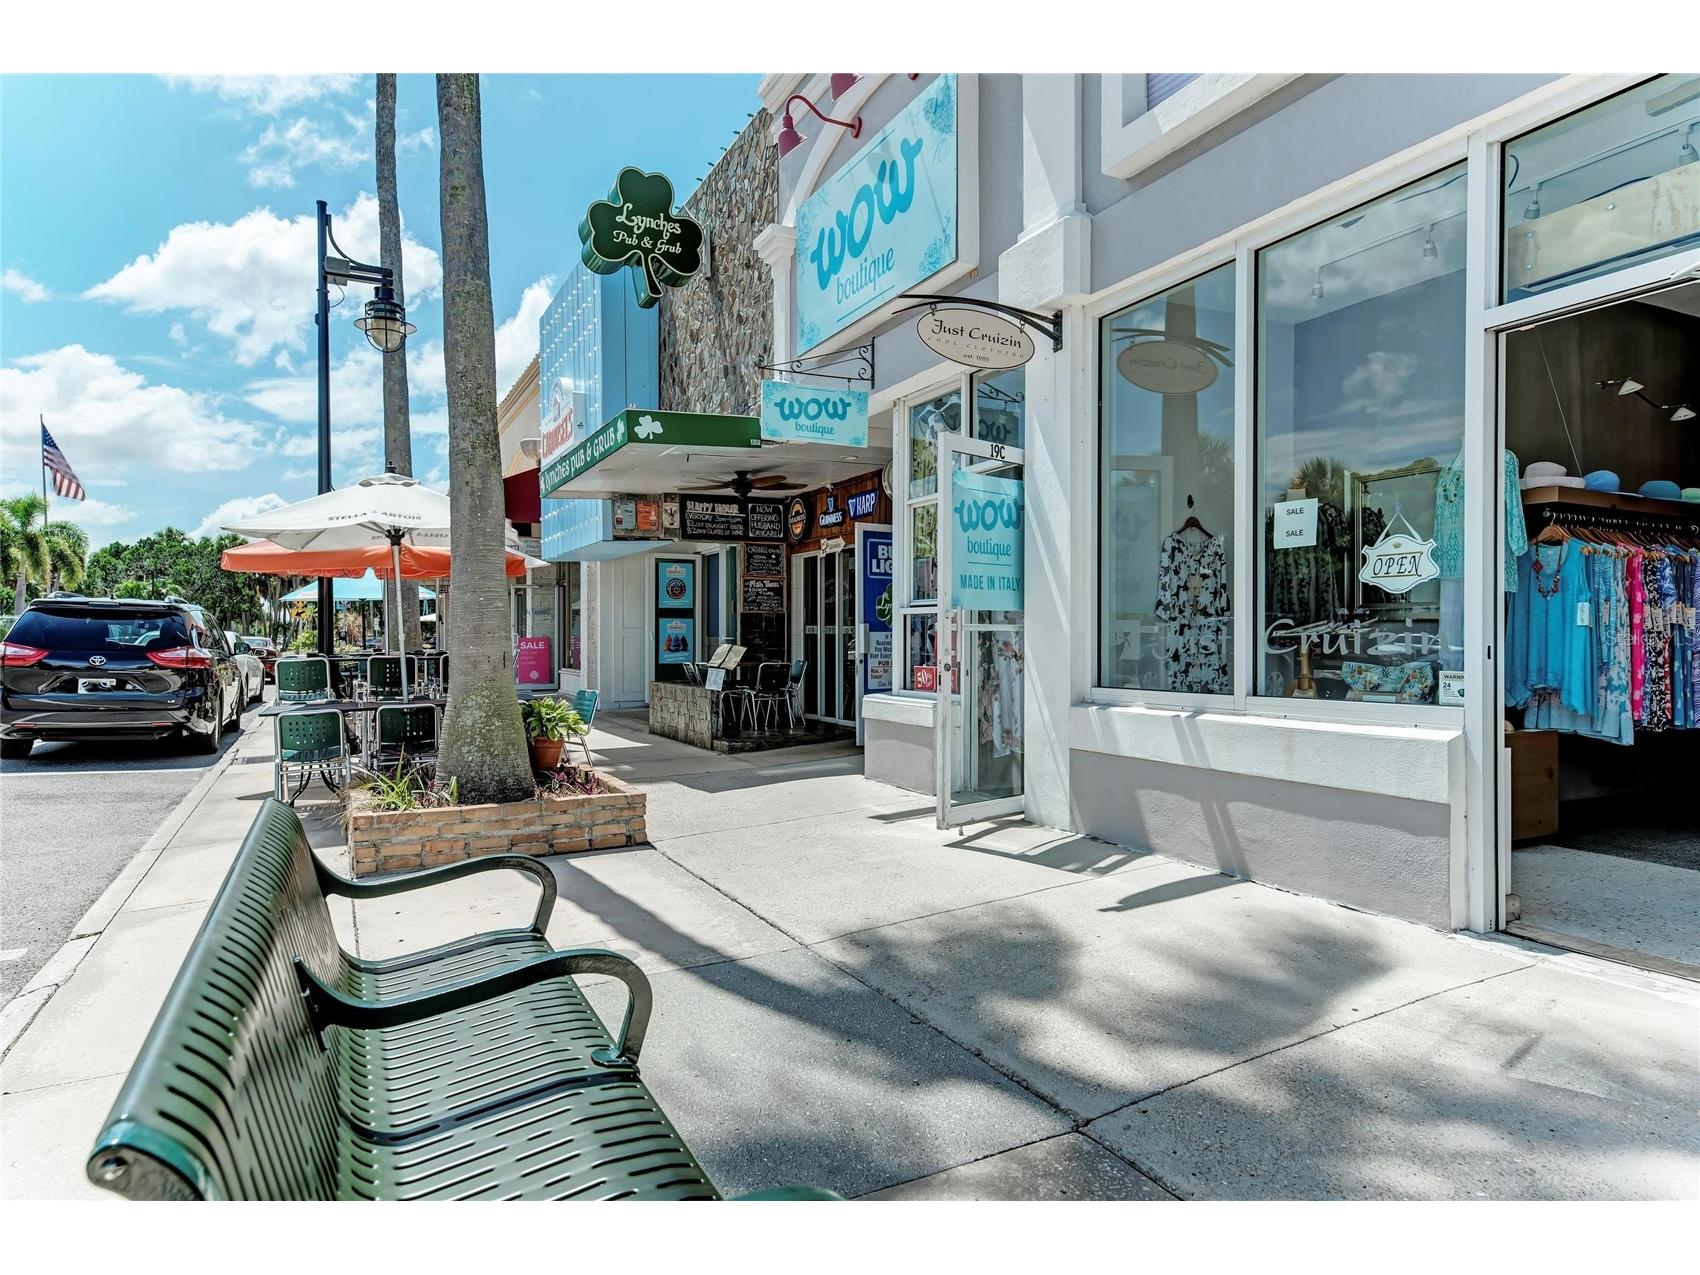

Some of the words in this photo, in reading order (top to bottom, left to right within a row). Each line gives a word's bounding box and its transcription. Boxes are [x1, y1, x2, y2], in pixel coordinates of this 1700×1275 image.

[615, 203, 681, 239] Lynches
[613, 230, 638, 248] Pub
[641, 237, 653, 248] &
[655, 239, 682, 254] Grub
[836, 248, 895, 304] boutique
[931, 319, 965, 337] Just
[968, 327, 1022, 349] Cruizin
[928, 336, 958, 346] COOL
[966, 344, 1024, 359] CLOTHING
[795, 421, 835, 437] boutique
[586, 442, 592, 461] &
[990, 444, 1006, 460] 19C
[687, 501, 714, 513] HAPPY
[715, 503, 740, 514] HOUR
[857, 493, 876, 516] HARP
[328, 512, 367, 521] STELLA
[381, 511, 422, 520] ARTOIS
[685, 513, 713, 521] EVERYDAY
[820, 512, 842, 526] GUINNESS
[751, 521, 780, 530] HUSBAND
[752, 529, 780, 537] DAYCARE!
[1285, 529, 1304, 537] SALE
[967, 535, 1012, 561] boutique
[872, 559, 892, 573] LIG
[1373, 553, 1424, 577] OPEN
[960, 574, 984, 590] MADE
[987, 575, 996, 590] IN
[998, 576, 1021, 592] ITALY
[1264, 618, 1449, 656] Cruizin
